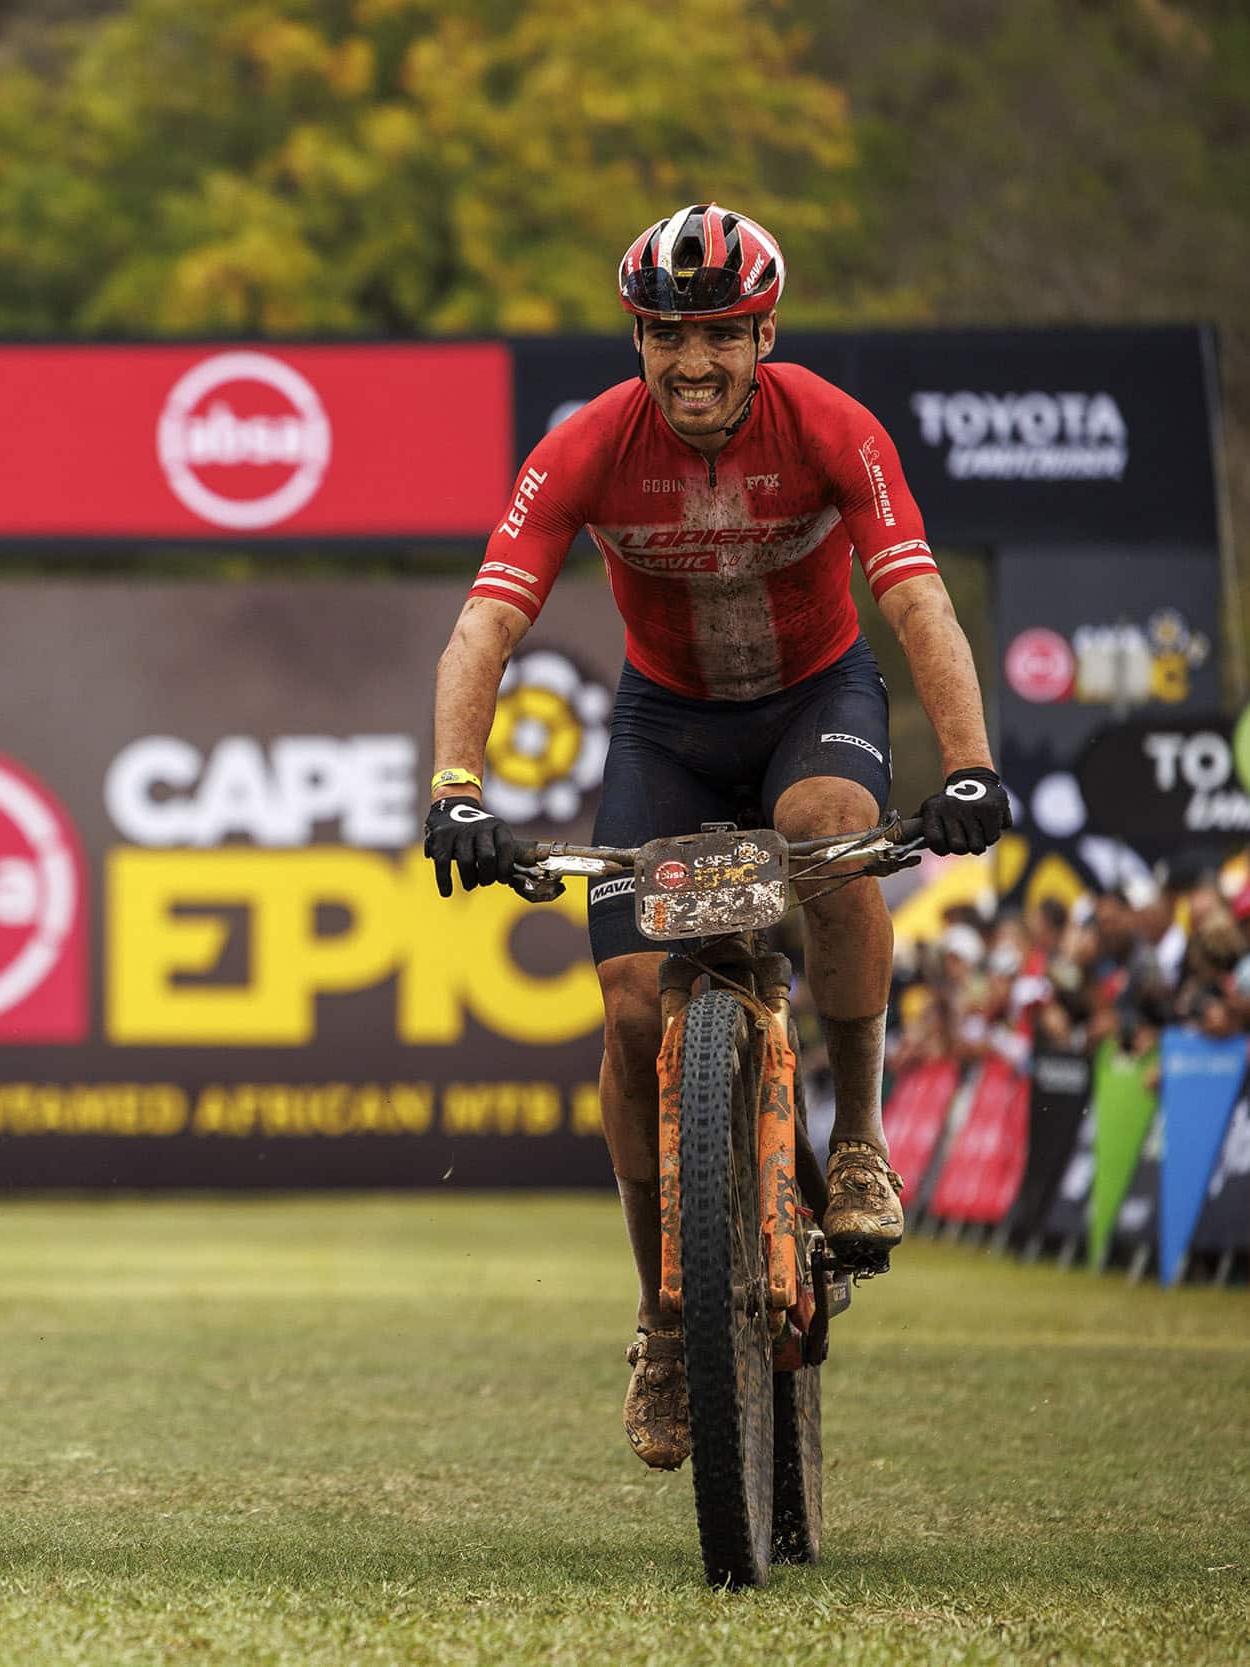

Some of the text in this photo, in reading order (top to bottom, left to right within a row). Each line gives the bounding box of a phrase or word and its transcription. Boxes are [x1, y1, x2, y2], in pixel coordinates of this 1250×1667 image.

[186, 398, 307, 467] absa
[911, 391, 1126, 448] TOYOTA
[498, 467, 549, 540] ZEFAL
[871, 463, 896, 527] MICHELIN
[103, 735, 418, 846] CAPE
[693, 854, 733, 868] CAPE
[102, 848, 604, 1048] EPIC
[193, 1081, 434, 1138] AFRICAN
